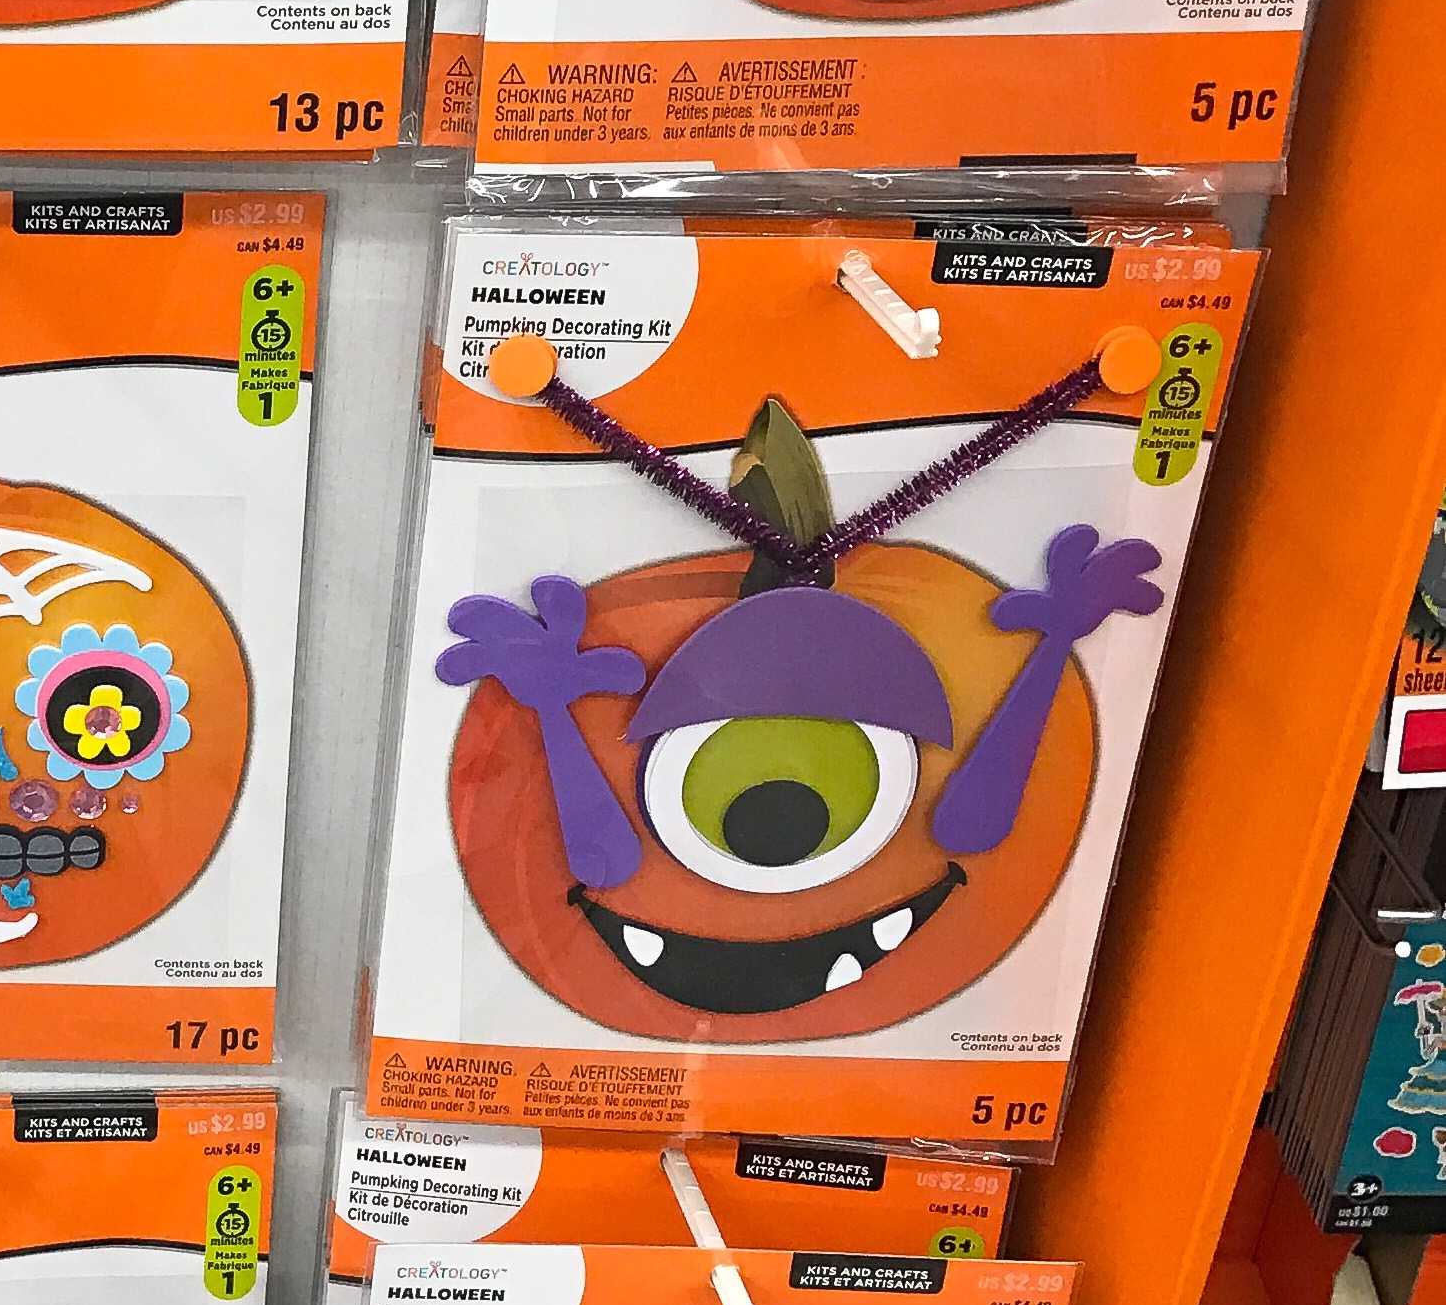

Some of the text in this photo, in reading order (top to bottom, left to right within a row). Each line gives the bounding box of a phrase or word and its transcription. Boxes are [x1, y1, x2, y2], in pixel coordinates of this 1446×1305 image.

[257, 4, 392, 18] Contents on back
[271, 17, 391, 31] Contenu au dos
[497, 87, 634, 104] CHOKING HAZARD
[1191, 82, 1278, 130] 5 pc
[269, 93, 384, 140] 13 pc
[25, 218, 171, 231] KITS ET ARTISANAT
[953, 255, 1093, 271] KITS AND CRAFTS
[253, 277, 294, 301] 6+
[472, 286, 606, 305] HALLOWEEN
[552, 317, 672, 339] Decorating Kit
[1169, 335, 1213, 358] 6+
[258, 393, 273, 419] 1
[166, 1021, 259, 1056] 17 pc
[30, 1117, 143, 1127] KITS AND CRAFTS
[972, 1096, 1049, 1131] 5 pc
[357, 1148, 466, 1171] HALLOWEEN
[218, 1176, 252, 1195] 6+
[351, 1171, 522, 1202] Pumpking Decorating Kit
[938, 1235, 976, 1254] 6+
[807, 1265, 929, 1279] KITS AND CRAFTS
[222, 1272, 234, 1294] 1
[388, 1287, 505, 1301] HALLOWEEN
